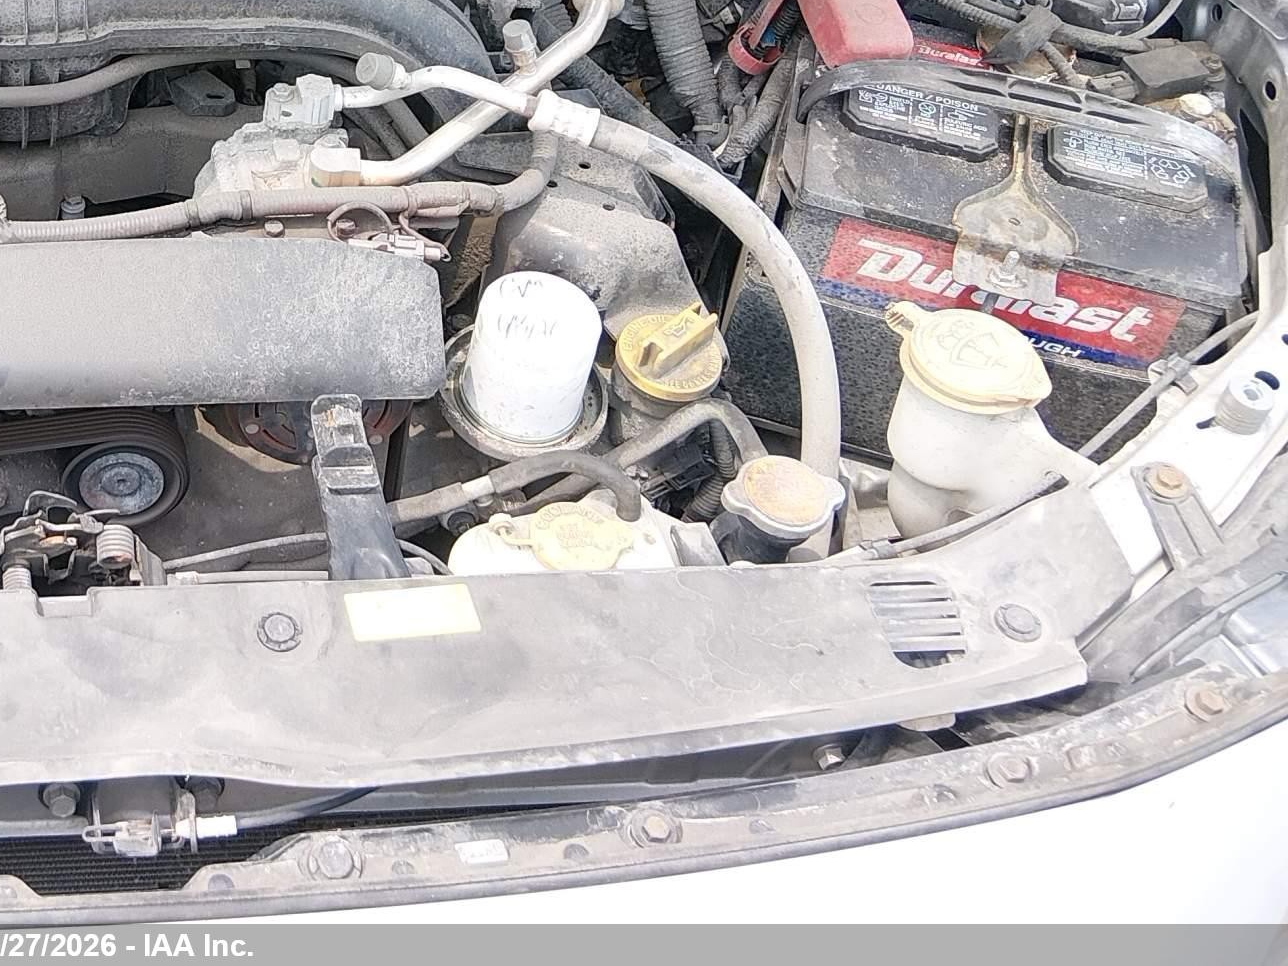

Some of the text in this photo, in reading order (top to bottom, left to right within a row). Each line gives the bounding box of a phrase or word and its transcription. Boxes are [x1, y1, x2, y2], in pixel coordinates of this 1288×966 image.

[935, 96, 979, 112] POISON
[623, 314, 667, 352] ENGINE OIL
[1027, 337, 1083, 358] UGH
